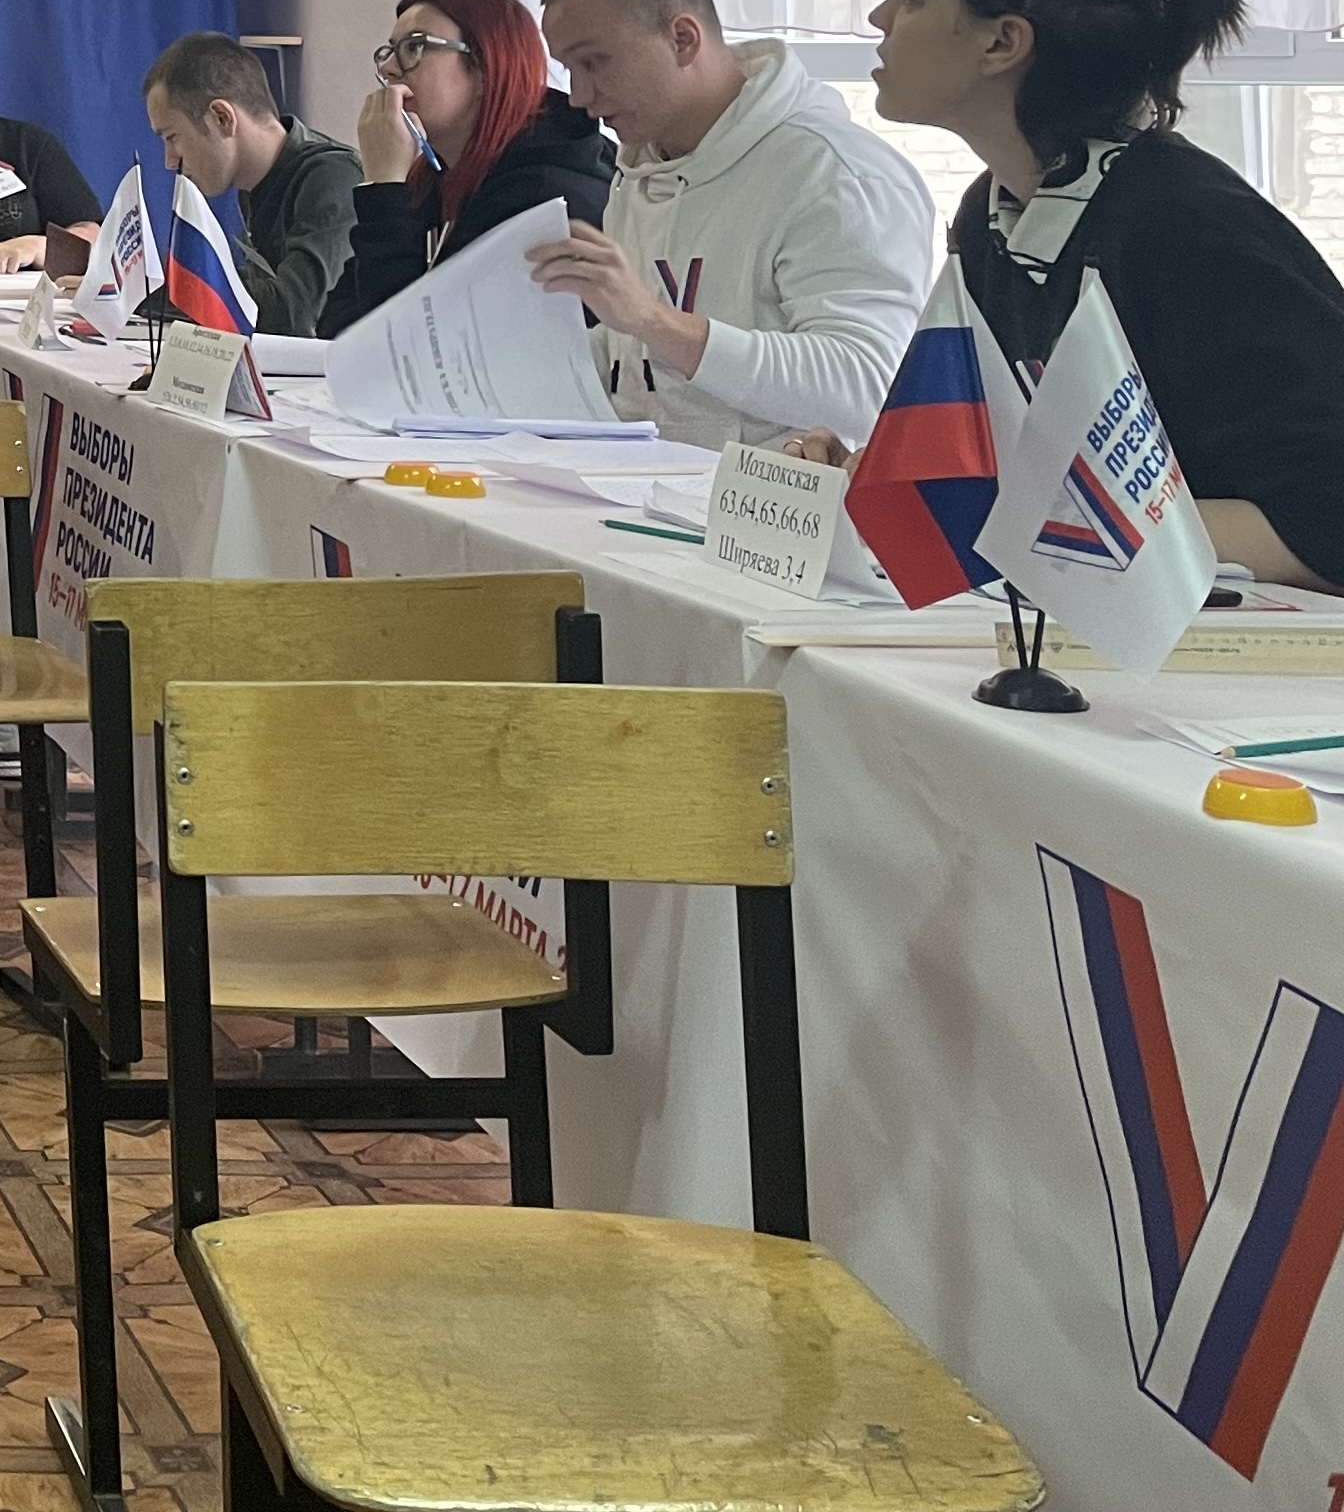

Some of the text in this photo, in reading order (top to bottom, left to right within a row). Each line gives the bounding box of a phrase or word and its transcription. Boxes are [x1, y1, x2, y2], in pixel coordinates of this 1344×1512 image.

[69, 411, 135, 486] ВЫБОРЫ
[735, 449, 821, 494] Моздокская
[62, 466, 155, 566] ПРЕЗИДЕНТА
[718, 534, 780, 574] Ширяева
